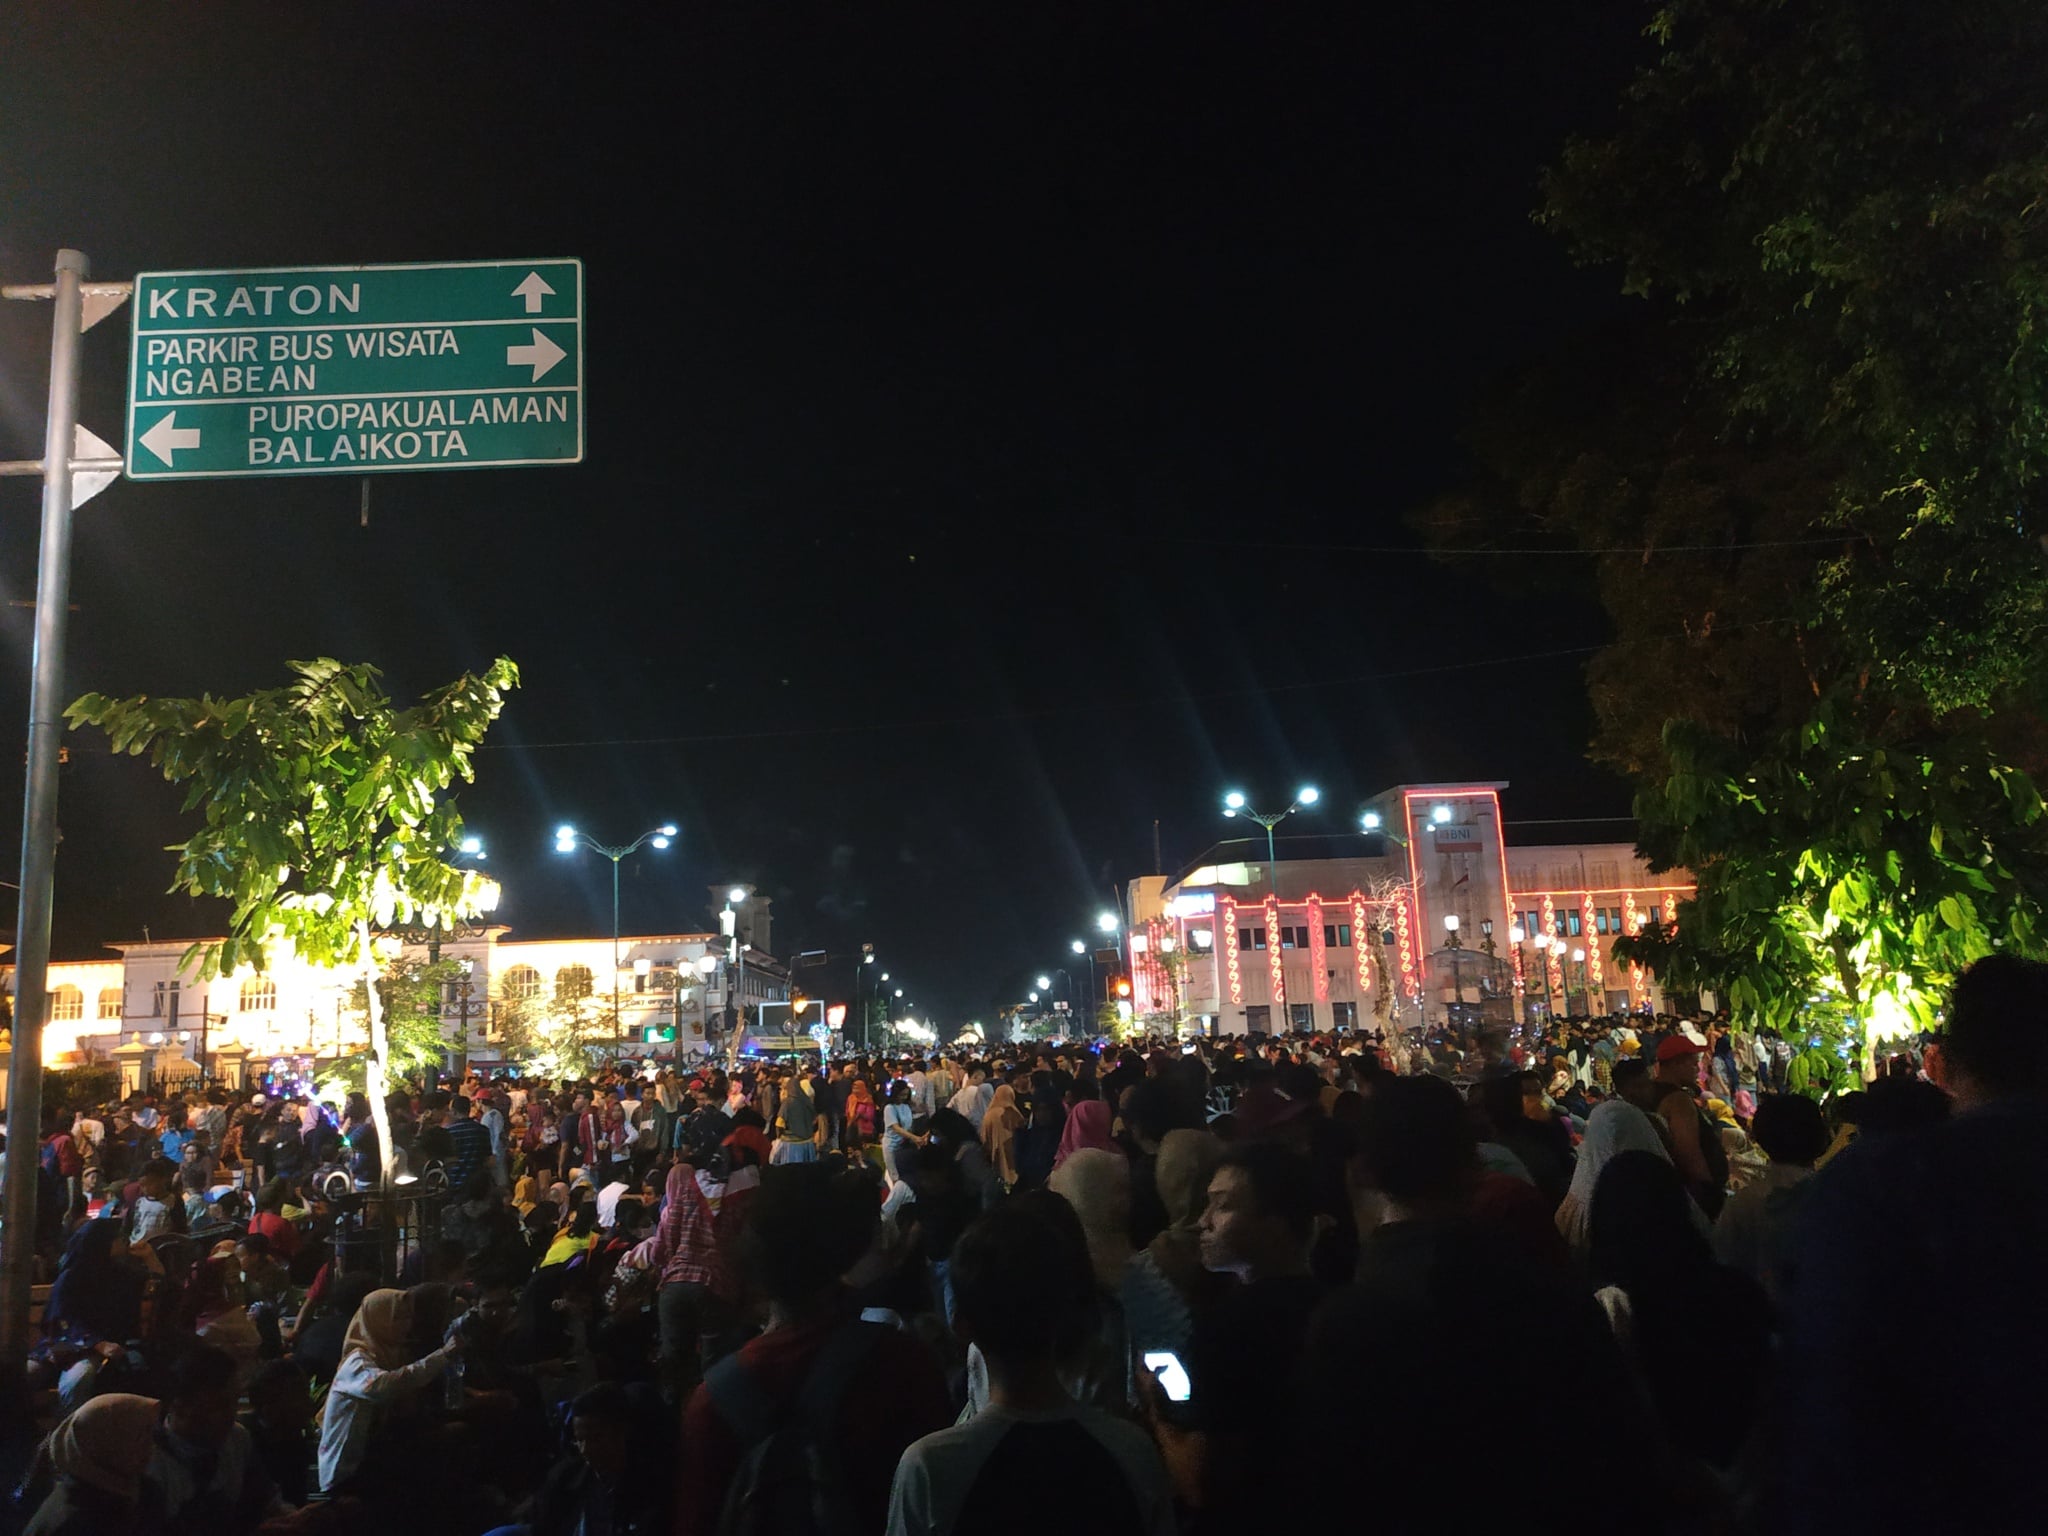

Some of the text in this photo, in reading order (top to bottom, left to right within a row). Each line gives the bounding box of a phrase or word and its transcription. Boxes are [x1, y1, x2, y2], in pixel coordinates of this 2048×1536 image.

[149, 283, 360, 319] KRATON
[147, 329, 459, 365] PARKIR BUS WISATA
[146, 365, 316, 396] NGABEAN
[249, 397, 568, 432] PUROPAKUALAMAN
[1451, 829, 1470, 840] BNI
